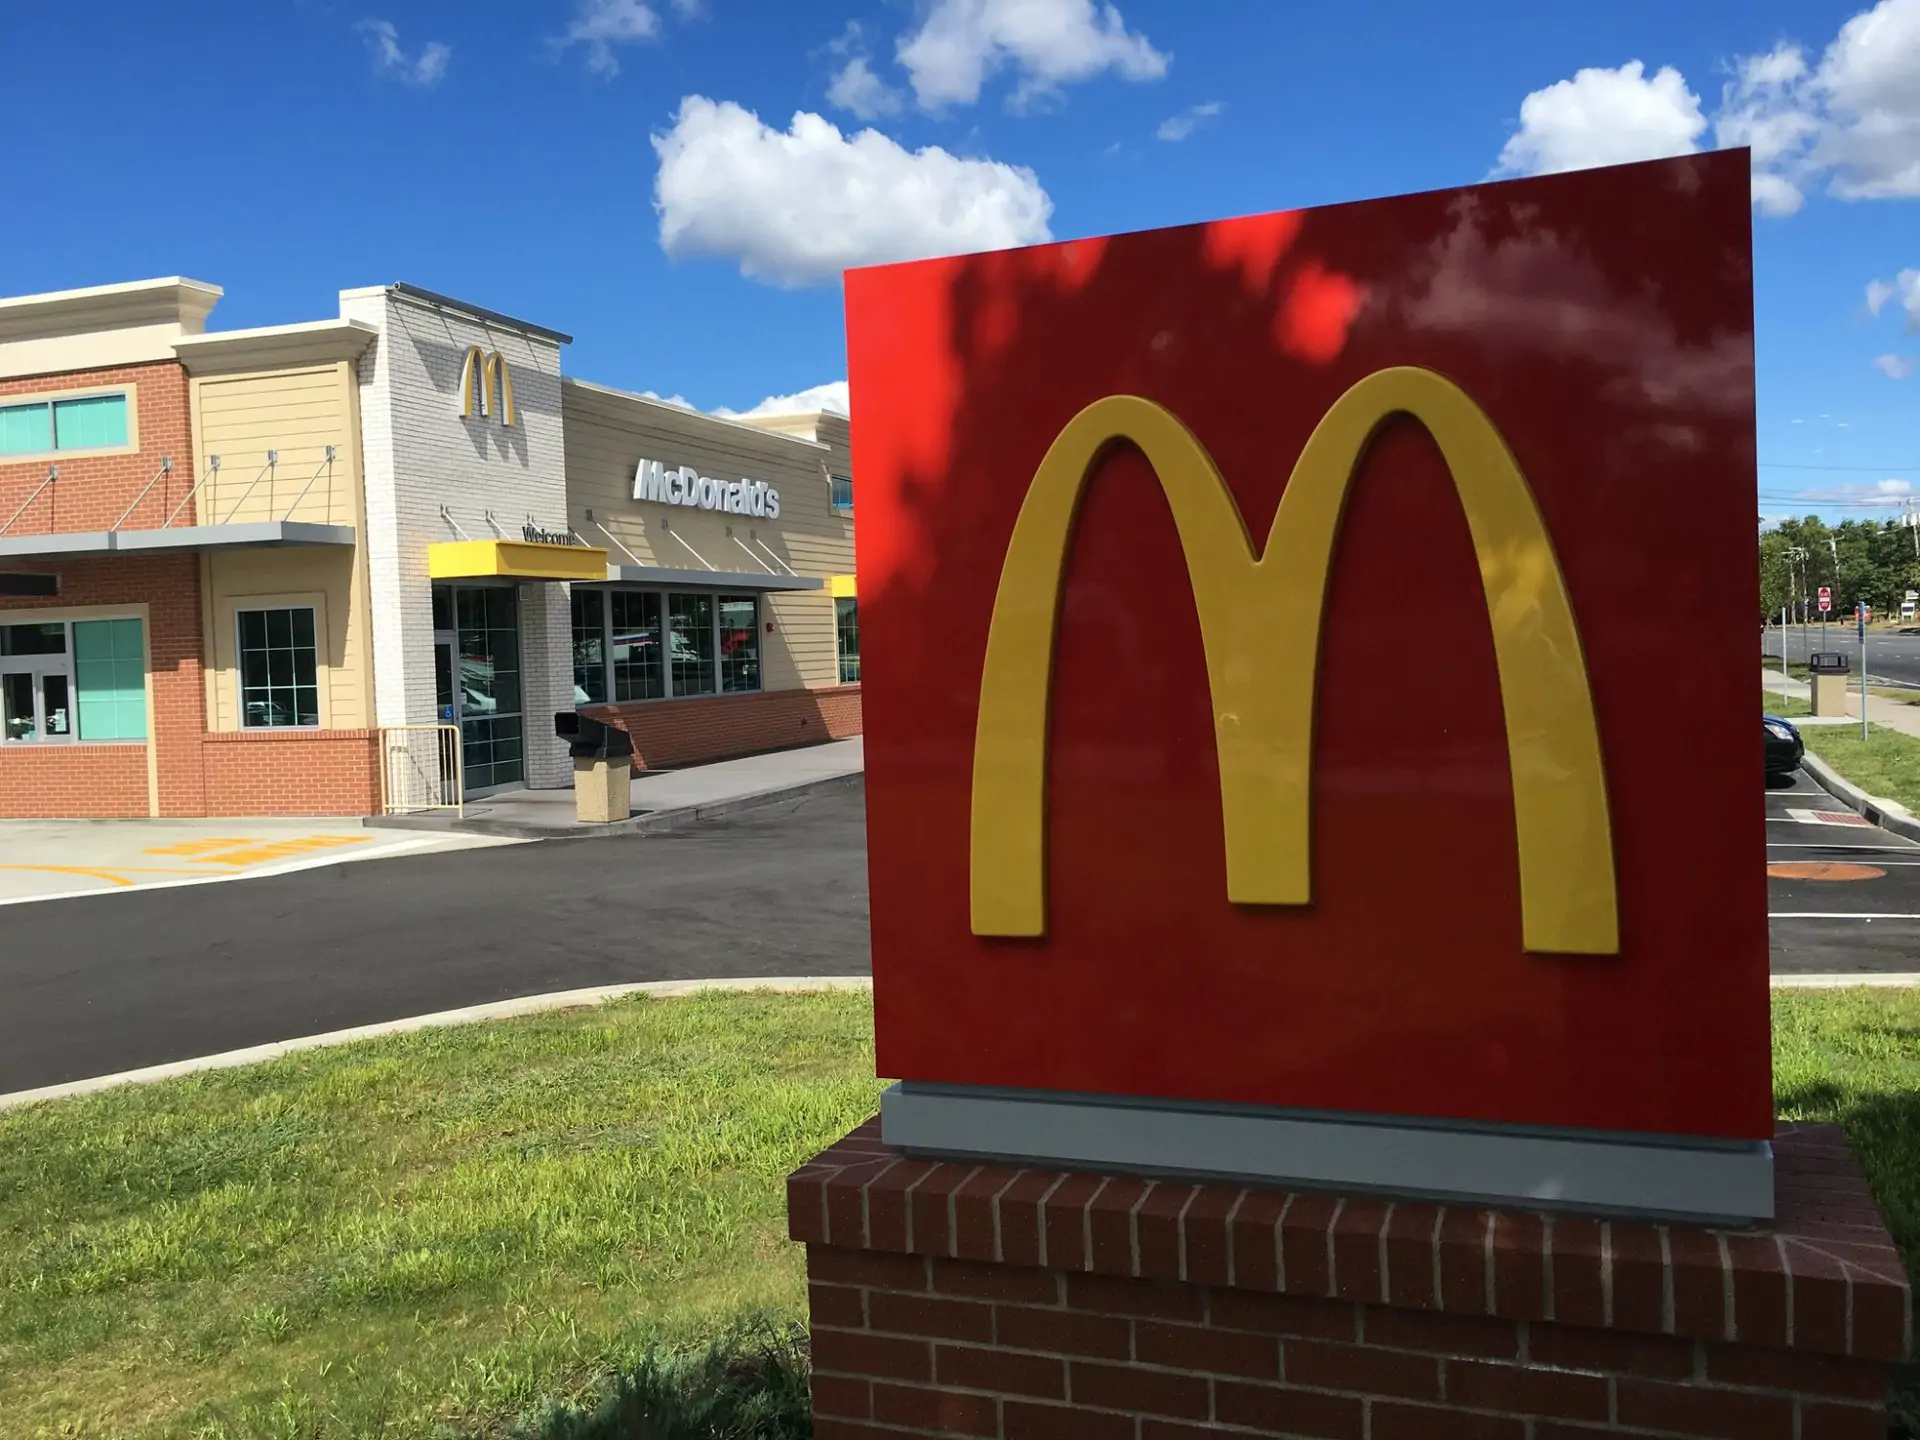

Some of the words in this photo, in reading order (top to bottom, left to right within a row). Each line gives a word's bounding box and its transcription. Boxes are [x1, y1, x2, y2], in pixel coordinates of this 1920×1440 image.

[458, 345, 516, 428] M
[633, 458, 780, 519] McDonald's
[522, 526, 576, 546] Welcome
[970, 365, 1620, 955] M
